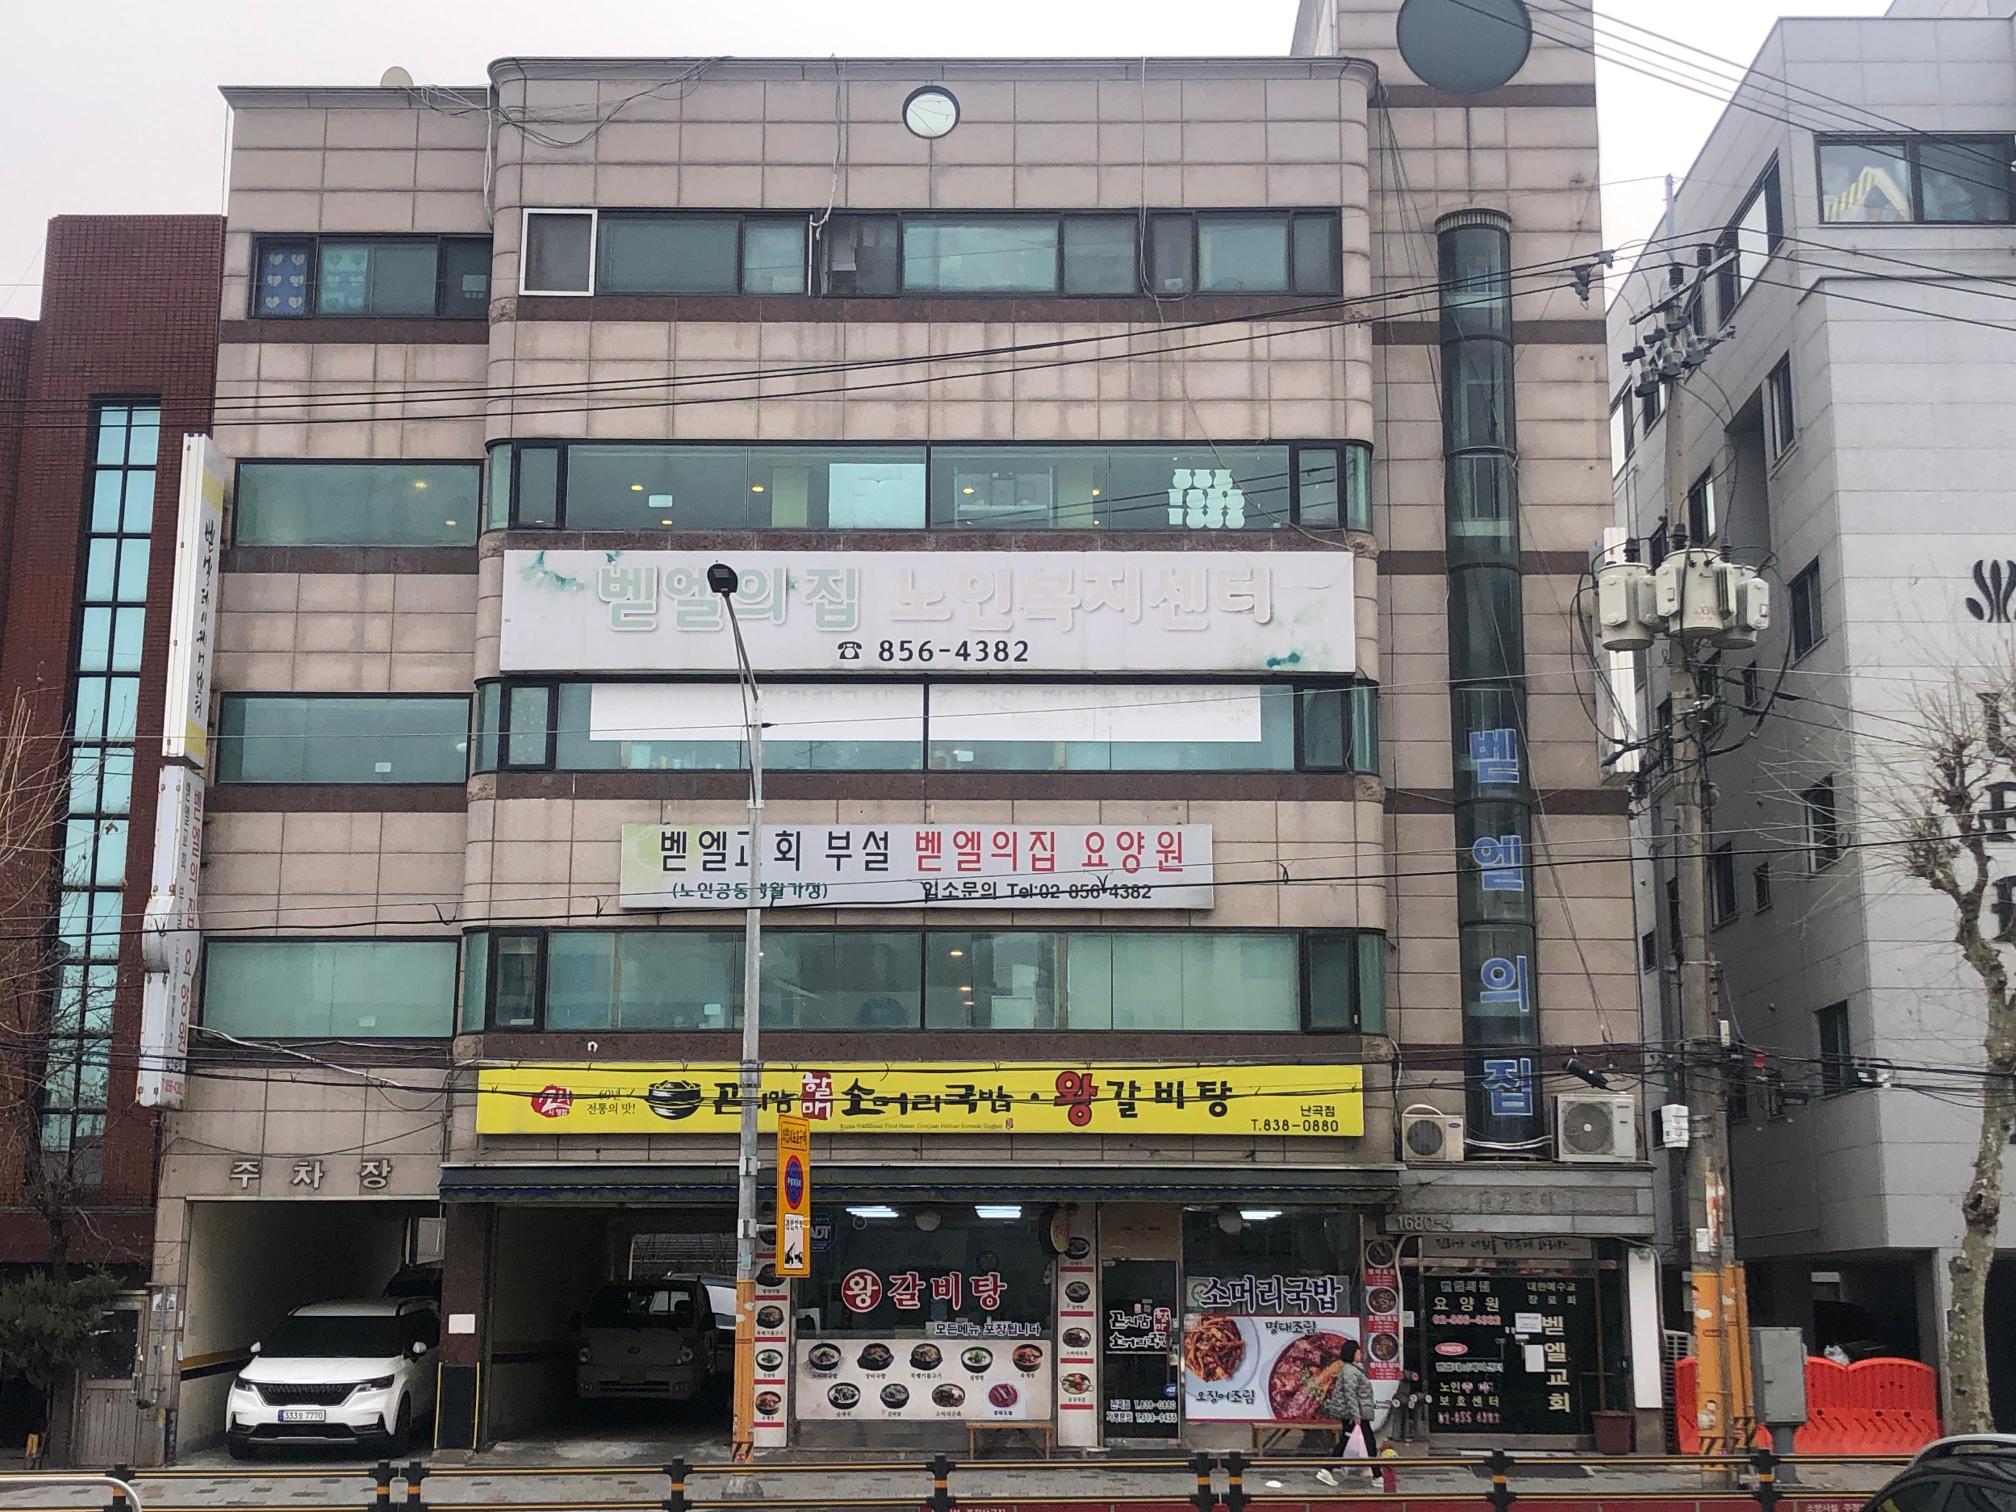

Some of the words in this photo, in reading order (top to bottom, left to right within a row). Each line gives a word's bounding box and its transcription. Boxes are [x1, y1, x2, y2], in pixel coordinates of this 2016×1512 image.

[598, 565, 861, 632] 벧엘의집
[890, 565, 1275, 632] 노인복지센터
[879, 639, 1030, 663] 856-4382
[825, 829, 889, 872] 부설
[915, 830, 1056, 873] 벧엘의집
[1081, 830, 1184, 874] 요양원
[1469, 728, 1532, 1117] 벧엘의집
[587, 1102, 618, 1115] 전통의
[841, 1078, 1014, 1116] 소머리국밥
[1300, 1105, 1335, 1117] 난곡점
[1251, 1119, 1339, 1133] T.838-0880
[229, 1158, 392, 1189] 주차장
[842, 1269, 1007, 1313] 왕갈비탕
[1200, 1275, 1344, 1314] 소머리국밥
[1433, 1296, 1500, 1312] 요양원
[935, 1322, 981, 1337] 모든메뉴
[983, 1322, 1042, 1337] 포장됩니다
[1265, 1320, 1317, 1334] 명태조림
[1542, 1316, 1571, 1413] 벧엘교회
[1195, 1390, 1255, 1405] 오징어조림
